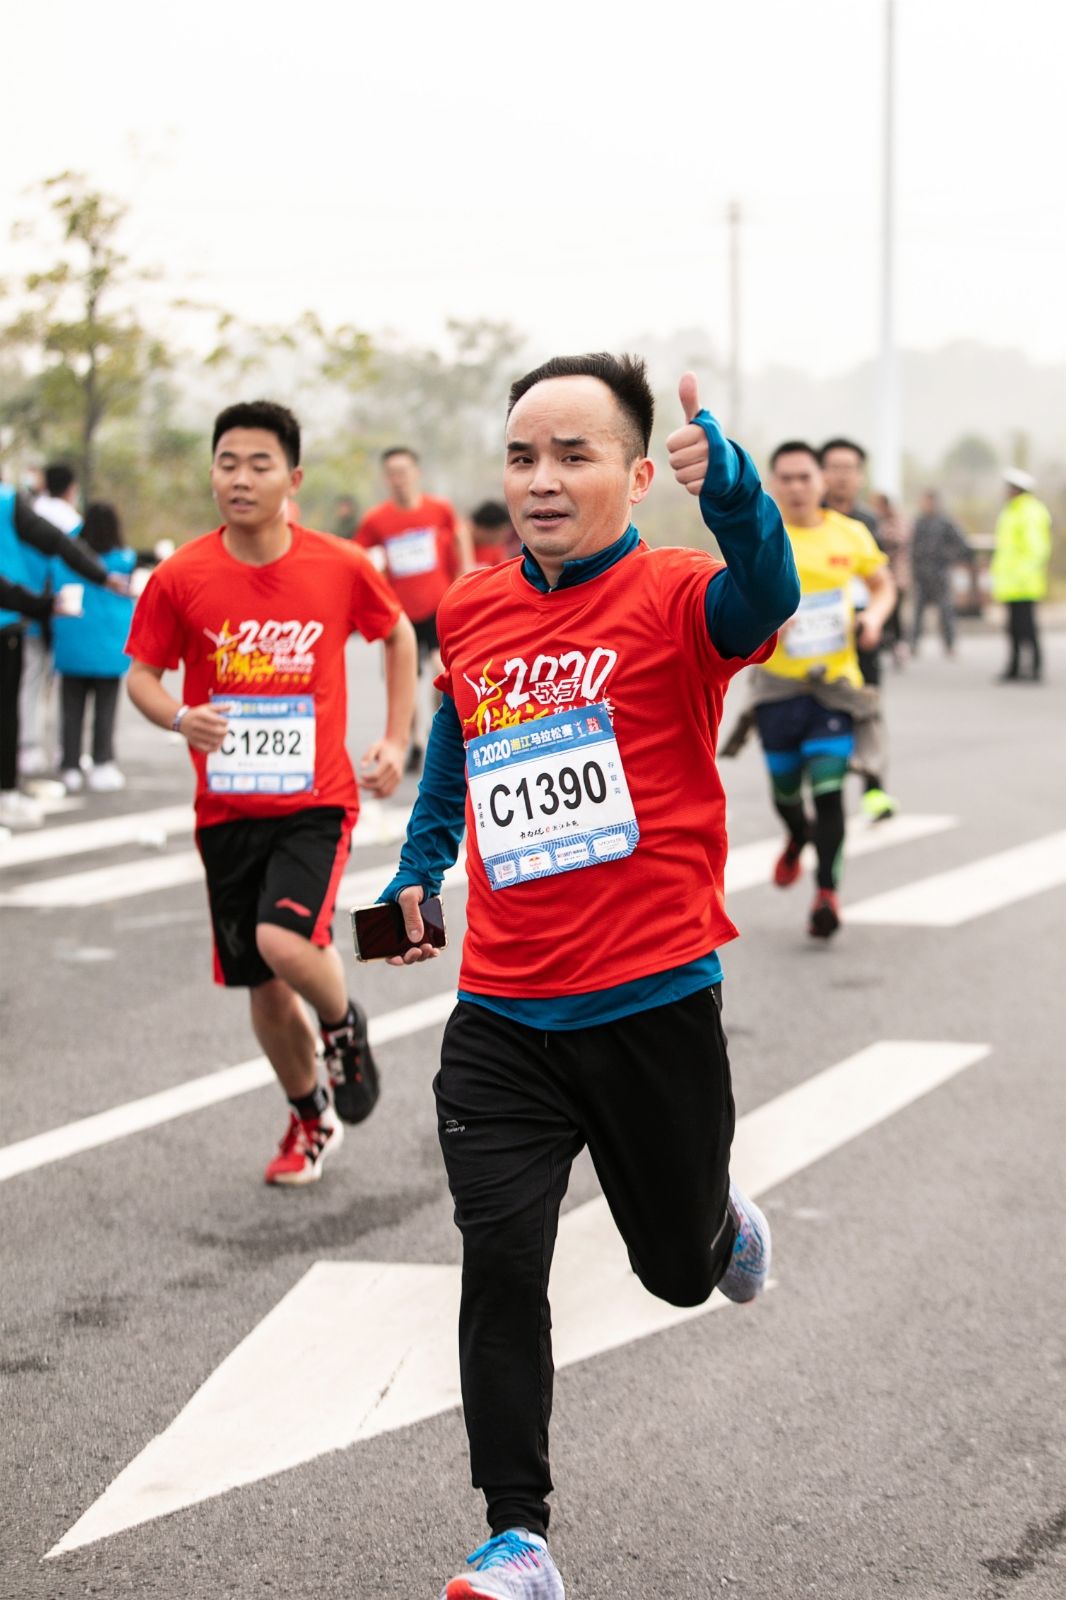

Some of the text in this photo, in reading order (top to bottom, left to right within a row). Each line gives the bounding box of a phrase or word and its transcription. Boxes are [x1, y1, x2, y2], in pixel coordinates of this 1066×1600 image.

[239, 619, 324, 655] 2020
[503, 646, 618, 710] 2020
[220, 729, 302, 756] C1282
[480, 740, 511, 766] 2020
[490, 761, 607, 828] C1390
